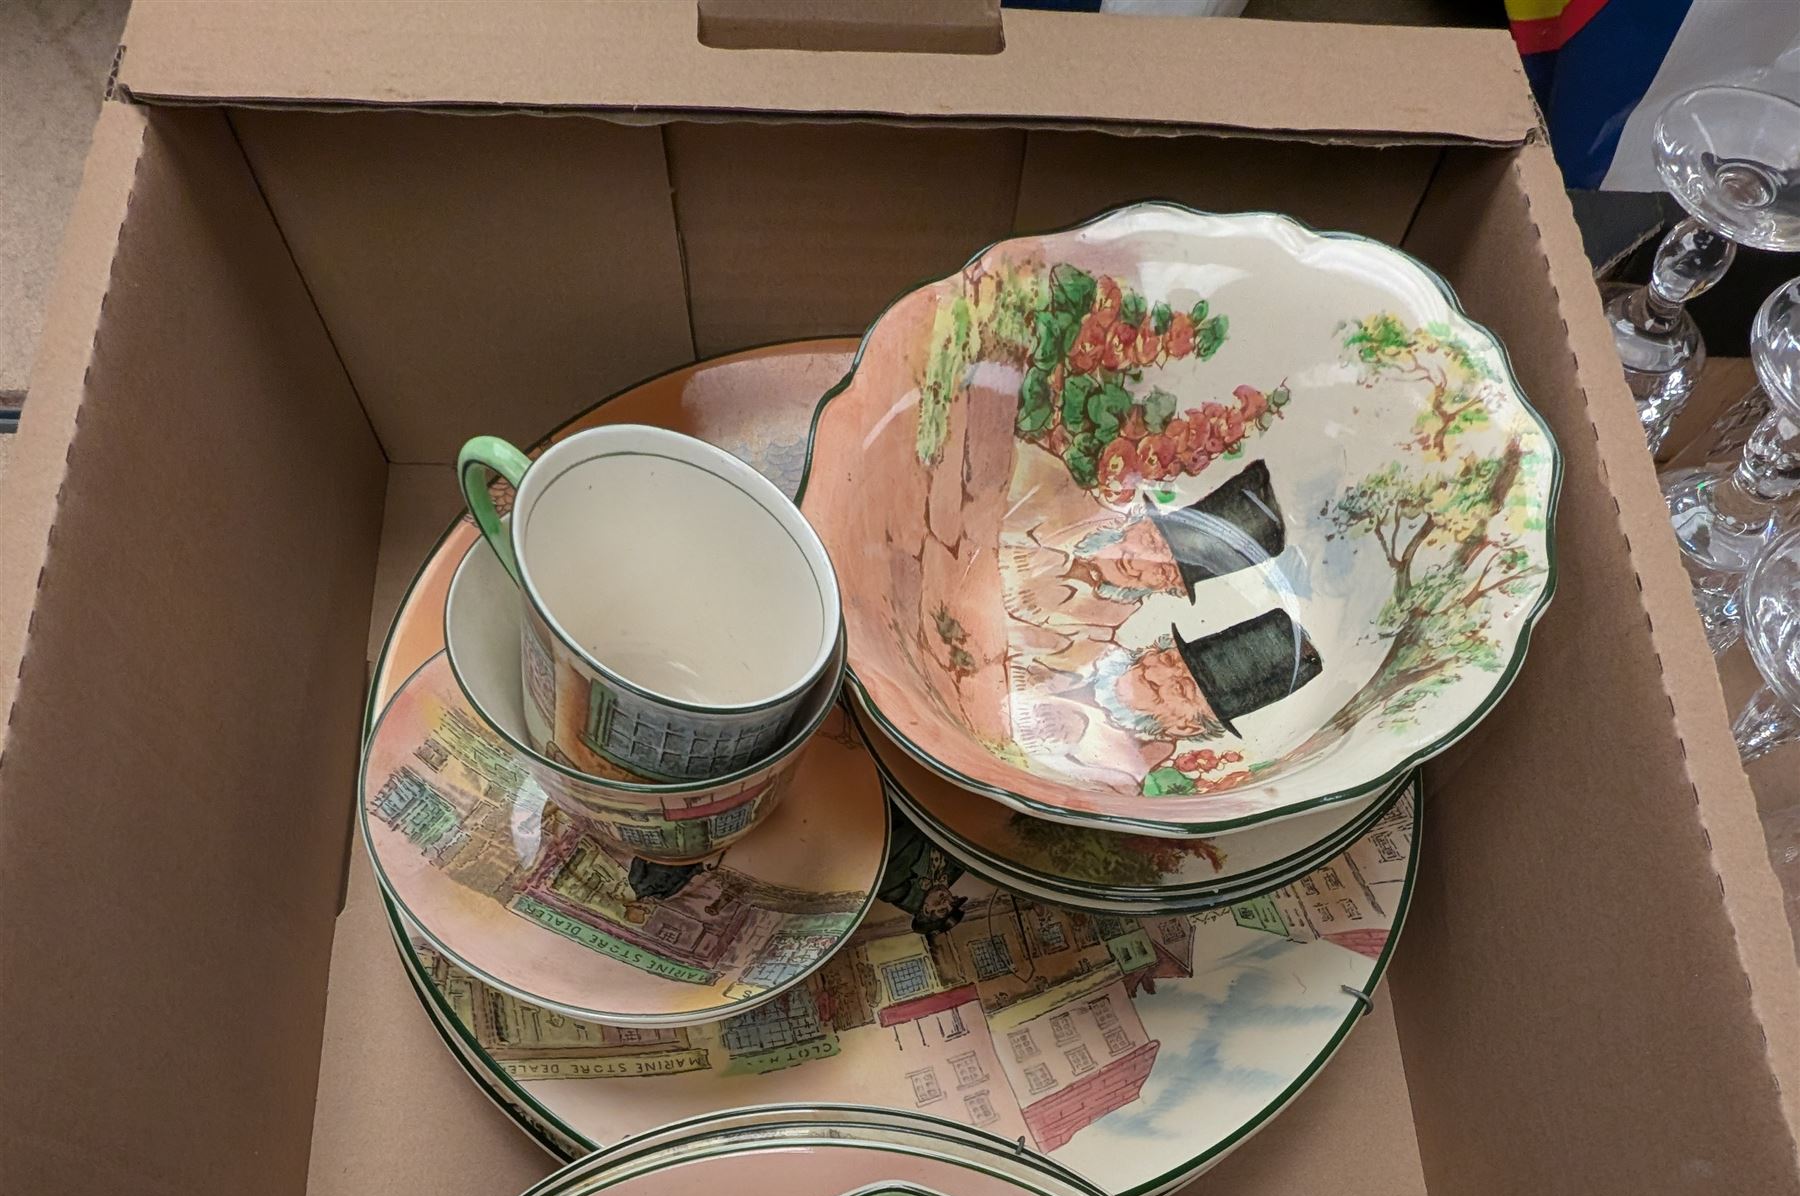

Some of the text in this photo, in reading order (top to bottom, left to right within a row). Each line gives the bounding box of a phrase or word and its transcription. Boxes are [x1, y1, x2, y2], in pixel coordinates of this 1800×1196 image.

[525, 903, 713, 983] MARINE STORE DEALER
[503, 1057, 701, 1075] MARINE STORE DEALE
